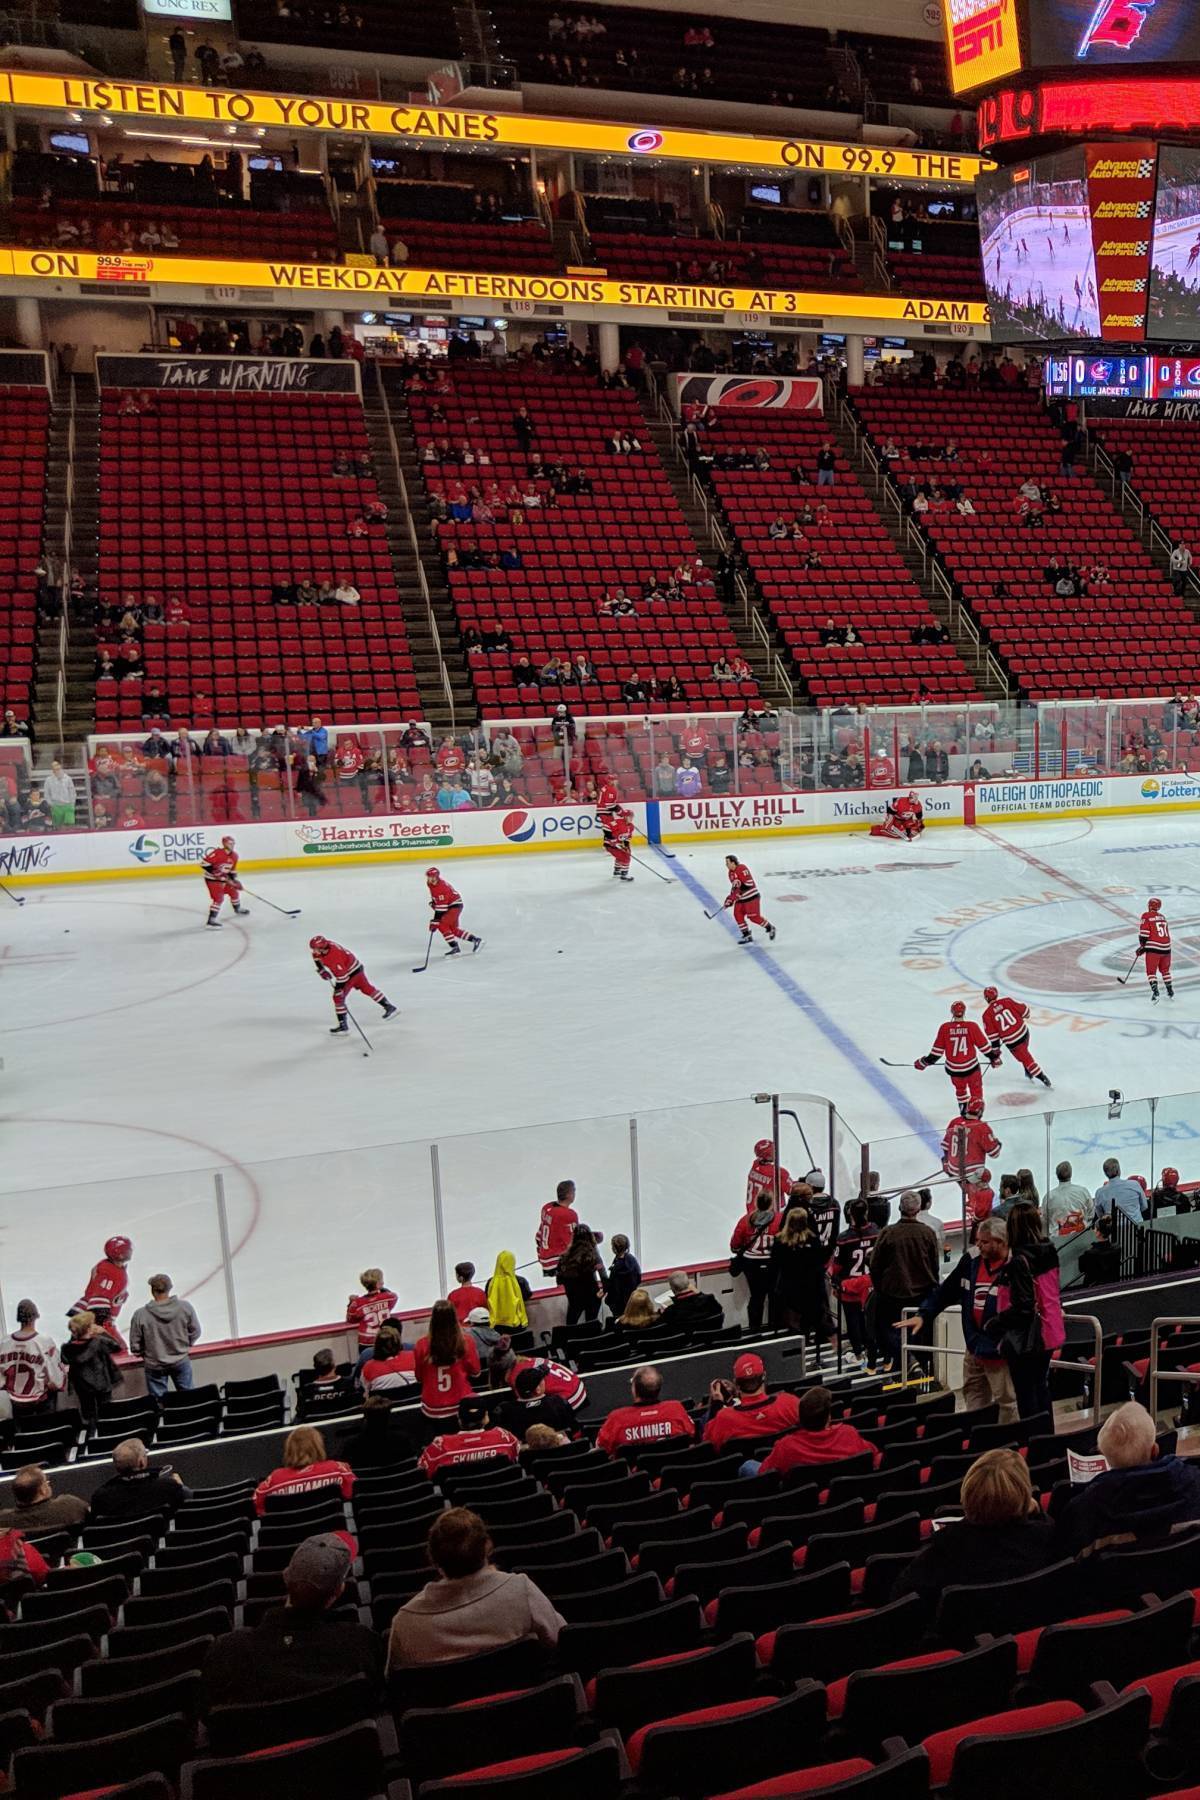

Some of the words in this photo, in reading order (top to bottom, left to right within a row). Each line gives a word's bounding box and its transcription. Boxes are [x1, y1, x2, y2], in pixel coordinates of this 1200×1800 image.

[190, 0, 220, 14] REX
[64, 79, 185, 116] LISTEN
[206, 93, 255, 122] TO
[275, 99, 371, 130] YOUR
[390, 108, 500, 141] CANES
[781, 142, 825, 169] ON
[842, 149, 896, 173] 99.9
[912, 154, 962, 180] THE
[1095, 159, 1138, 170] Advance
[1089, 169, 1112, 178] Auto
[1112, 169, 1137, 178] Parts
[1093, 209, 1114, 218] Auto
[1114, 210, 1136, 218] Parts
[1098, 201, 1136, 211] Advance
[1097, 248, 1115, 256] Auto
[1115, 249, 1135, 257] Parts
[1101, 241, 1136, 250] Advance
[31, 254, 79, 276] ON
[97, 256, 122, 267] 99.9
[270, 264, 408, 293] WEEKDAY
[425, 276, 605, 303] AFTERNOONS
[619, 284, 735, 310] STARTING
[749, 291, 779, 311] AT
[784, 294, 797, 313] 3
[1104, 279, 1135, 287] Advance
[1116, 285, 1134, 293] Parts
[218, 287, 236, 298] 117
[514, 301, 530, 311] 118
[902, 301, 970, 323] ADAM
[744, 313, 759, 323] 119
[953, 325, 967, 334] 120
[1075, 360, 1085, 383] 0
[1128, 365, 1138, 381] 0
[1161, 366, 1170, 381] 0
[1081, 386, 1097, 395] BLUE
[1098, 387, 1130, 396] JACKETS
[979, 786, 1026, 802] RALEIGH
[1029, 781, 1104, 800] ORTHOPAEDIC
[669, 800, 745, 820] BULLY
[753, 797, 805, 816] HILL
[925, 799, 951, 811] Son
[991, 802, 1027, 812] OFFICIAL
[1030, 801, 1053, 810] TEAM
[1055, 799, 1092, 808] DOCTORS
[694, 815, 784, 830] VINEYARDS
[163, 832, 205, 848] DUKE
[322, 825, 384, 842] Harris
[389, 823, 450, 838] Teeter
[318, 842, 371, 852] Neighborhood
[372, 841, 391, 849] Food
[401, 837, 440, 848] Pharmacy
[901, 927, 951, 955] PNC
[934, 891, 1074, 928] ARENA
[1156, 922, 1168, 938] 57
[995, 1009, 1017, 1032] 20
[950, 1036, 969, 1057] 74
[5, 1364, 36, 1395] 17
[437, 1366, 451, 1392] 5
[625, 1421, 672, 1440] SKINNER
